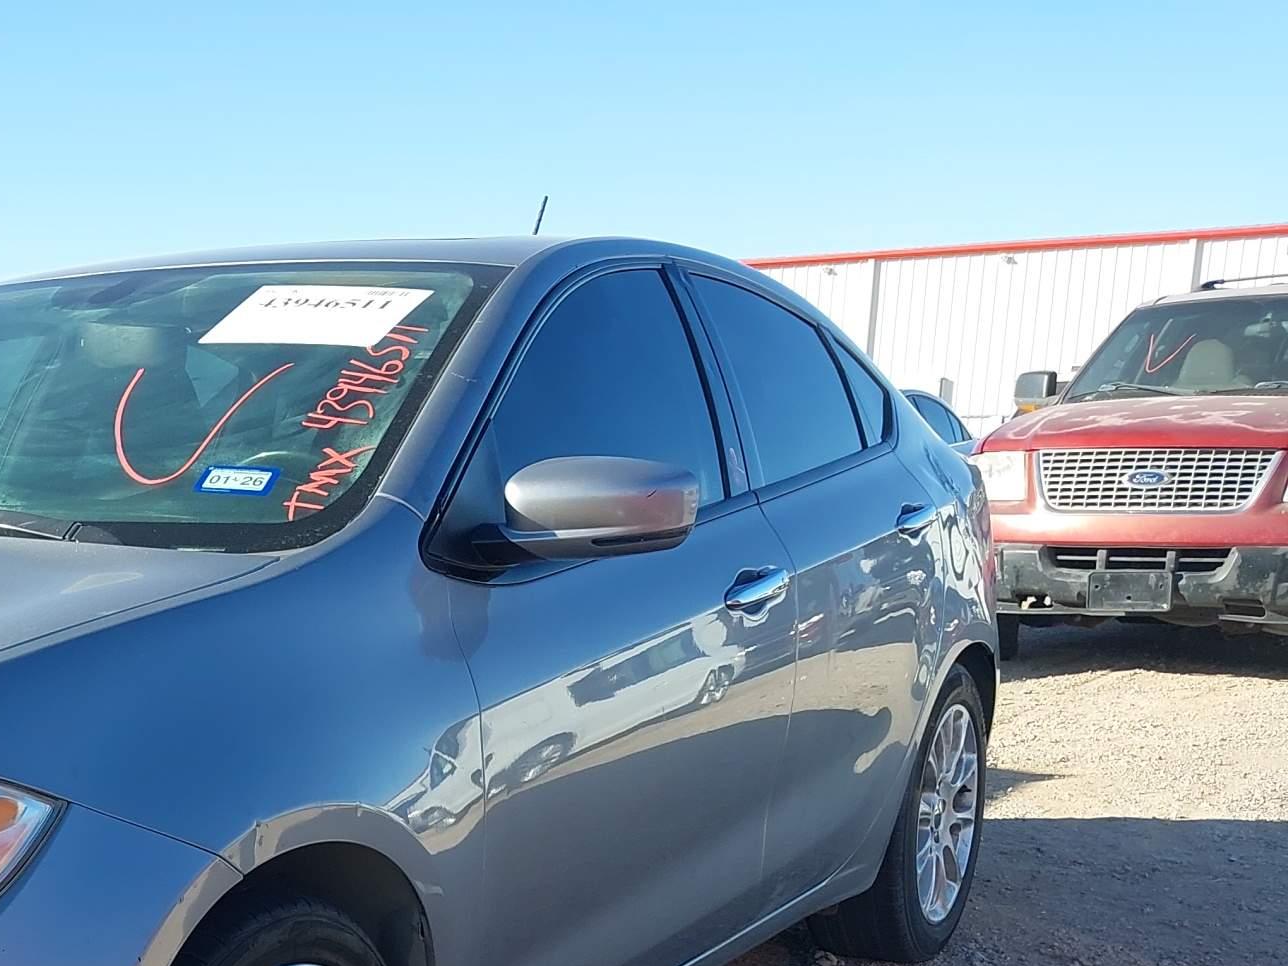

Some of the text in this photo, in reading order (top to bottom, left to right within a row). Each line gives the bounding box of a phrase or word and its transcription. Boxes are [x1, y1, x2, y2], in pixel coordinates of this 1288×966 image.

[259, 298, 393, 310] 43946511
[283, 324, 429, 521] TMX 43946511
